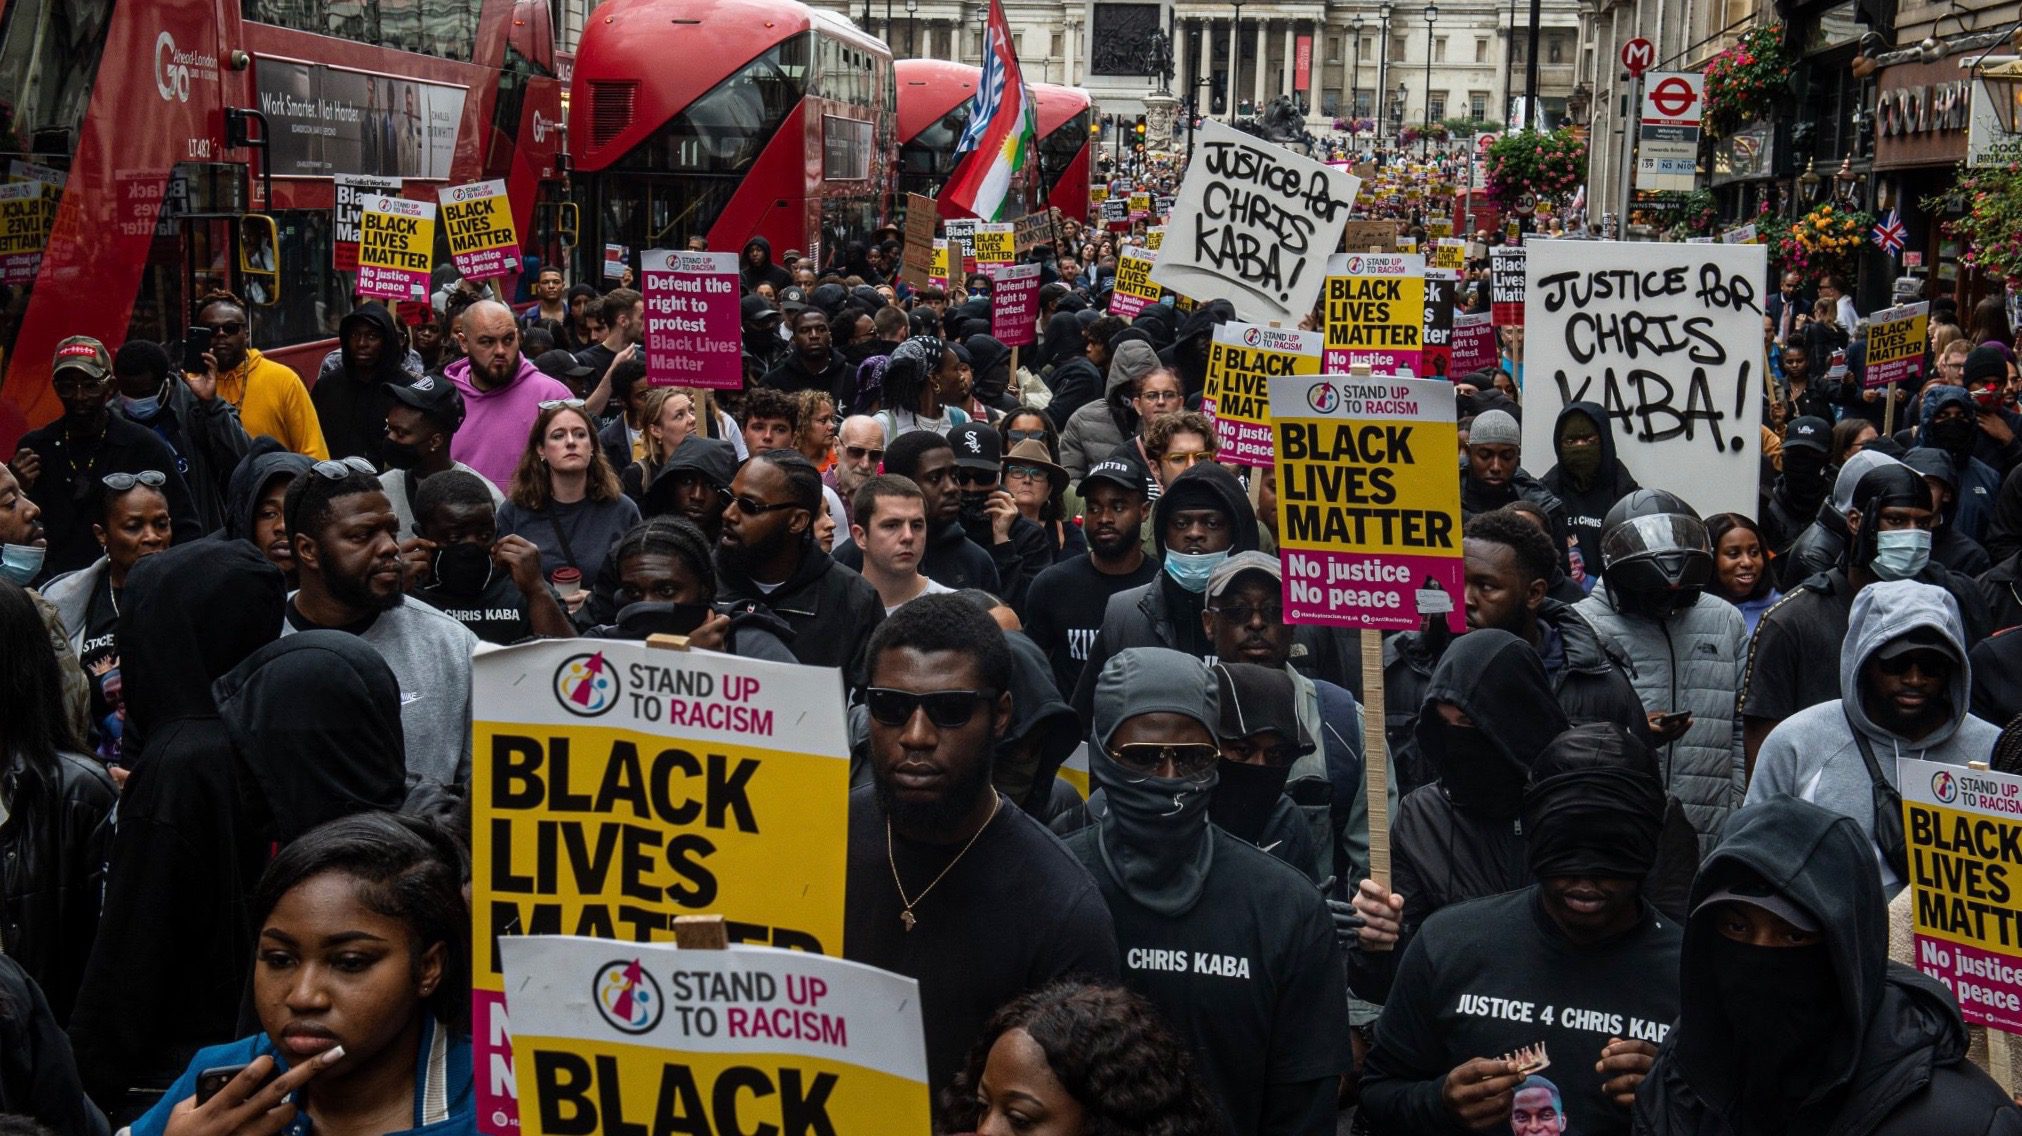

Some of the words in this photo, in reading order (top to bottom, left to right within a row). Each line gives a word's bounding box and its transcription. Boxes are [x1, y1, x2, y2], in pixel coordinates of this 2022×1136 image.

[1627, 44, 1650, 66] M
[261, 92, 285, 116] Work
[286, 94, 317, 119] Smarter.
[318, 98, 333, 121] Not
[334, 100, 360, 123] Harder.
[445, 199, 495, 221] BLACK
[1203, 181, 1316, 255] CHRIS
[365, 213, 418, 235] BLACK
[448, 216, 491, 236] LIVES
[946, 226, 975, 237] Black
[363, 230, 409, 250] LIVES
[451, 228, 514, 252] MATTER
[976, 234, 1005, 243] BLACK
[976, 243, 1002, 252] LIVES
[362, 246, 428, 270] MATTER
[456, 254, 470, 266] No
[470, 250, 502, 265] justice
[977, 251, 1013, 260] MATTER
[1196, 213, 1306, 302] KABA!
[1439, 245, 1458, 254] BLACK
[458, 264, 472, 275] No
[473, 261, 499, 275] peace
[1366, 258, 1390, 266] STAND
[1391, 258, 1402, 266] UP
[1366, 266, 1377, 274] TO
[1377, 266, 1406, 274] RACISM
[1492, 257, 1526, 272] Black
[360, 266, 375, 278] No
[376, 268, 410, 281] justice
[647, 274, 701, 293] Defend
[704, 277, 732, 293] the
[1119, 270, 1147, 284] LIVES
[1493, 272, 1525, 287] Lives
[360, 277, 374, 288] No
[375, 280, 405, 292] peace
[996, 280, 1025, 292] Defend
[1025, 279, 1038, 289] the
[1116, 280, 1158, 299] MATTER
[1330, 279, 1401, 301] BLACK
[1537, 265, 1690, 312] JUSTICE
[648, 294, 688, 314] right
[691, 298, 708, 313] to
[995, 294, 1017, 306] right
[1018, 293, 1028, 302] to
[1112, 300, 1121, 308] No
[1121, 303, 1141, 313] peace
[1114, 292, 1123, 301] No
[1123, 294, 1145, 307] justice
[995, 304, 1025, 318] protest
[1330, 302, 1390, 322] LIVES
[649, 316, 707, 333] protest
[1476, 326, 1491, 335] the
[1871, 319, 1913, 339] BLACK
[650, 334, 693, 351] Black
[696, 336, 738, 352] Lives
[1263, 331, 1287, 341] STAND
[1329, 324, 1418, 346] MATTER
[1469, 338, 1479, 346] to
[1565, 311, 1726, 365] CHRIS
[1870, 333, 1907, 351] LIVES
[1263, 340, 1272, 348] TO
[1273, 341, 1303, 352] RACISM
[1869, 341, 1922, 363] MATTER
[651, 354, 704, 372] Matter
[1225, 348, 1298, 376] BLACK
[1328, 352, 1346, 365] No
[1350, 352, 1394, 367] justice
[1867, 365, 1879, 374] No
[1880, 361, 1907, 373] justice
[1222, 371, 1268, 398] LIVE
[1867, 373, 1878, 381] No
[1879, 368, 1903, 380] peace
[1343, 384, 1387, 400] STAND
[1390, 386, 1409, 399] UP
[1344, 399, 1362, 414] TO
[1366, 401, 1418, 415] RACISM
[1218, 421, 1236, 436] No
[1218, 435, 1235, 450] No
[1236, 440, 1274, 457] peace
[1280, 423, 1415, 465] BLACK
[1283, 464, 1396, 505] LIVES
[1285, 504, 1453, 549] MATTER
[1578, 515, 1602, 528] CHRIS
[1288, 553, 1321, 578] No
[1326, 556, 1411, 585] justice
[1290, 579, 1323, 604] No
[1329, 588, 1400, 611] peace
[485, 608, 521, 621] KABA
[82, 633, 115, 653] STICE
[629, 663, 714, 698] STAND
[722, 675, 760, 702] UP
[629, 691, 662, 722] TO
[670, 698, 774, 737] RACISM
[490, 734, 762, 834] BLACK
[1960, 777, 1998, 795] STAND
[2001, 783, 2019, 798] UP
[1961, 791, 1976, 807] TO
[1910, 807, 2022, 864] BLACK
[490, 818, 718, 909] LIVES
[1913, 848, 2010, 904] LIVES
[1127, 948, 1188, 973] CHRIS
[1193, 951, 1251, 980] KABA
[1921, 940, 1950, 968] No
[1954, 949, 2022, 987] justice
[672, 970, 776, 1003] STAND
[785, 974, 828, 1006] UP
[1957, 979, 2021, 1012] peace
[674, 1006, 718, 1038] TO
[727, 1007, 848, 1048] RACISM
[1455, 994, 1536, 1024] JUSTICE
[1539, 1005, 1555, 1026] 4
[1561, 1007, 1623, 1035] CHRIS
[1628, 1017, 1671, 1043] KAB
[533, 1050, 840, 1136] BLACK
